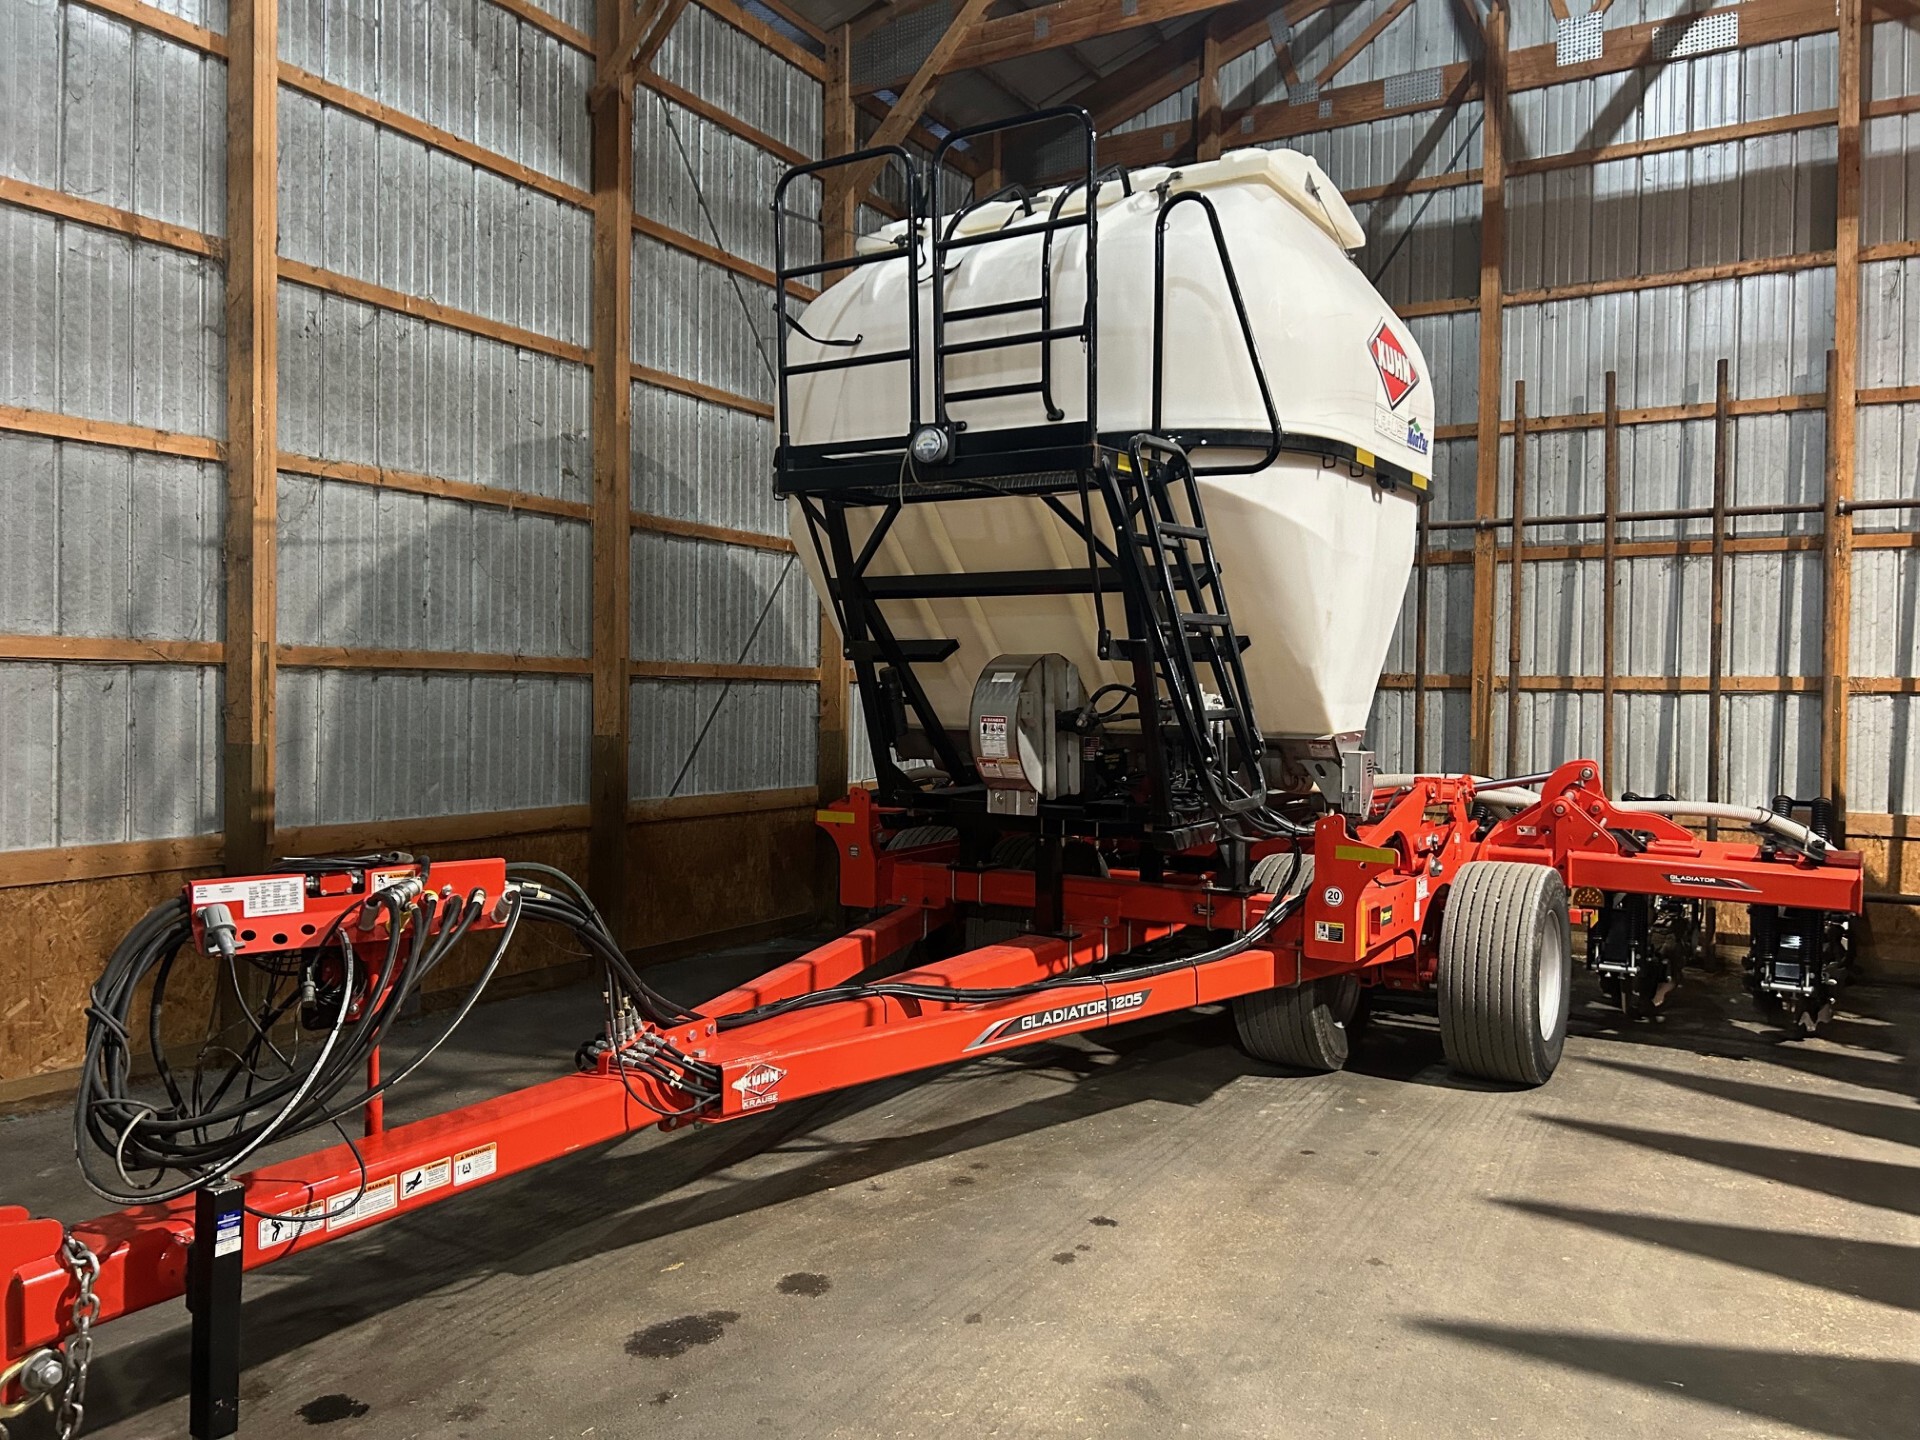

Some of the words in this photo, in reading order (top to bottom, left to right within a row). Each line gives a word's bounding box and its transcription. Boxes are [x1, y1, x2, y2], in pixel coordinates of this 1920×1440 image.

[1376, 337, 1412, 386] KUHN
[1670, 874, 1716, 883] GLADIATOR
[1327, 890, 1340, 900] 20
[1021, 1000, 1107, 1030] GLADIATOR
[1111, 992, 1143, 1010] 1205
[742, 1070, 779, 1087] KUHN
[743, 1094, 778, 1108] KRAUSE
[465, 1145, 491, 1158] WARNING
[367, 1180, 391, 1191] WARNING
